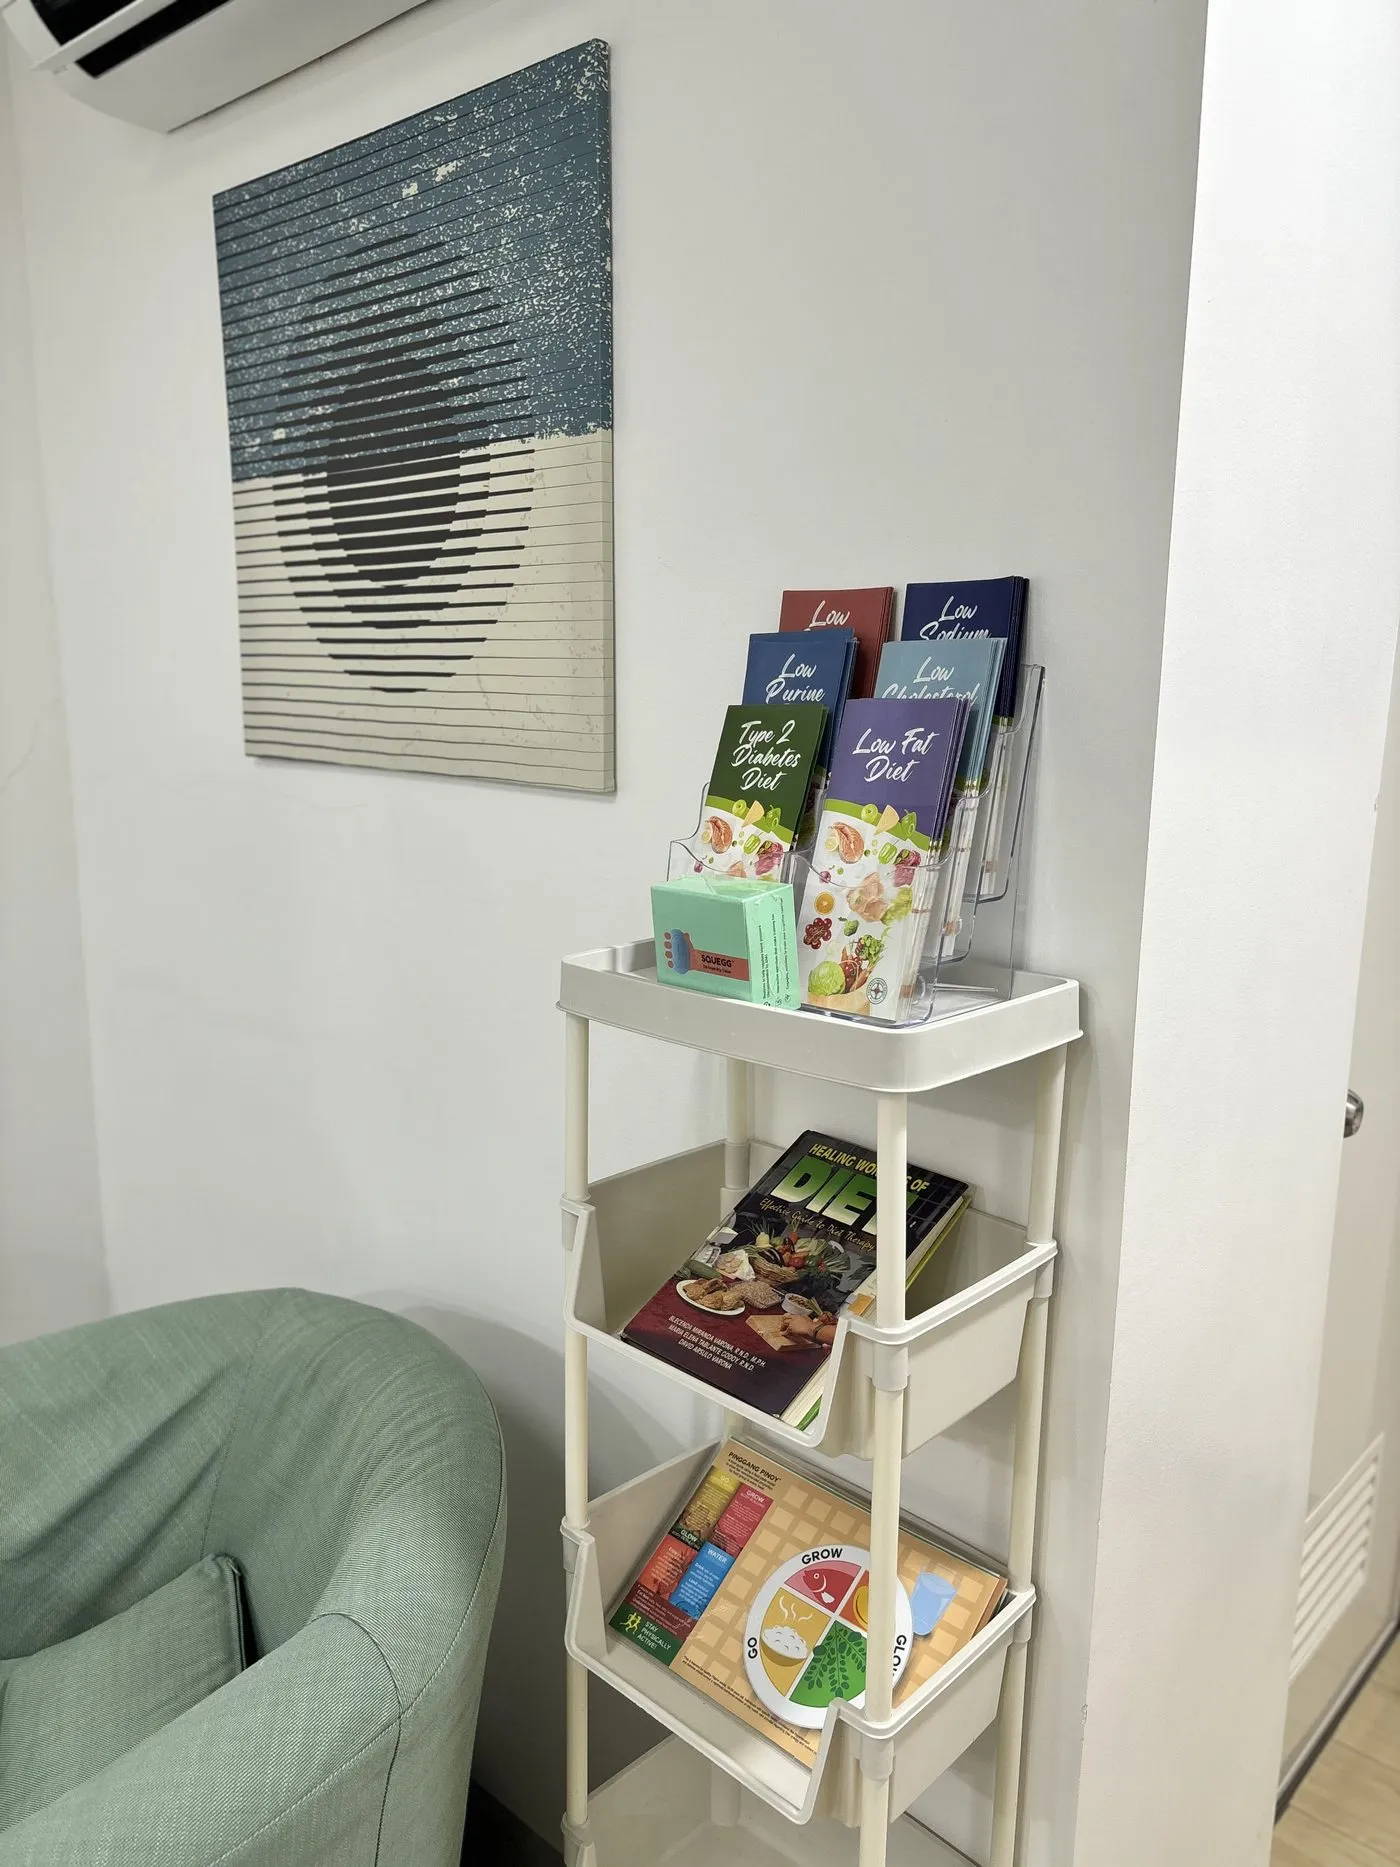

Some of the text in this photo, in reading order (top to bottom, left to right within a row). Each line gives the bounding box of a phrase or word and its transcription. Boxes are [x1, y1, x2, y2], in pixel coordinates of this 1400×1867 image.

[809, 600, 850, 627] Low
[938, 596, 977, 621] Low
[919, 620, 993, 641] Sodium
[779, 653, 817, 678] Low
[913, 656, 954, 684] Low
[765, 678, 825, 704] Purine
[738, 719, 796, 749] Type 2
[852, 727, 940, 755] Low Fat
[731, 744, 801, 768] Diabetes
[740, 767, 788, 791] Diet
[864, 755, 921, 783] Diet
[808, 1143, 930, 1192] HEALING OF
[759, 1198, 877, 1252] Effective Guide to Diet Therapy
[668, 1324, 685, 1336] MARIA
[678, 1338, 695, 1350] DAVID
[728, 1451, 760, 1472] PINGGANG
[746, 1490, 765, 1503] GROW
[680, 1529, 698, 1543] GLOW
[707, 1548, 728, 1564] WATER
[801, 1548, 843, 1565] GROW
[640, 1627, 672, 1650] PHYSICALLY
[645, 1621, 659, 1632] STAY
[637, 1633, 657, 1650] ACTIVE!
[747, 1636, 758, 1659] GO
[892, 1634, 907, 1676] GLO
